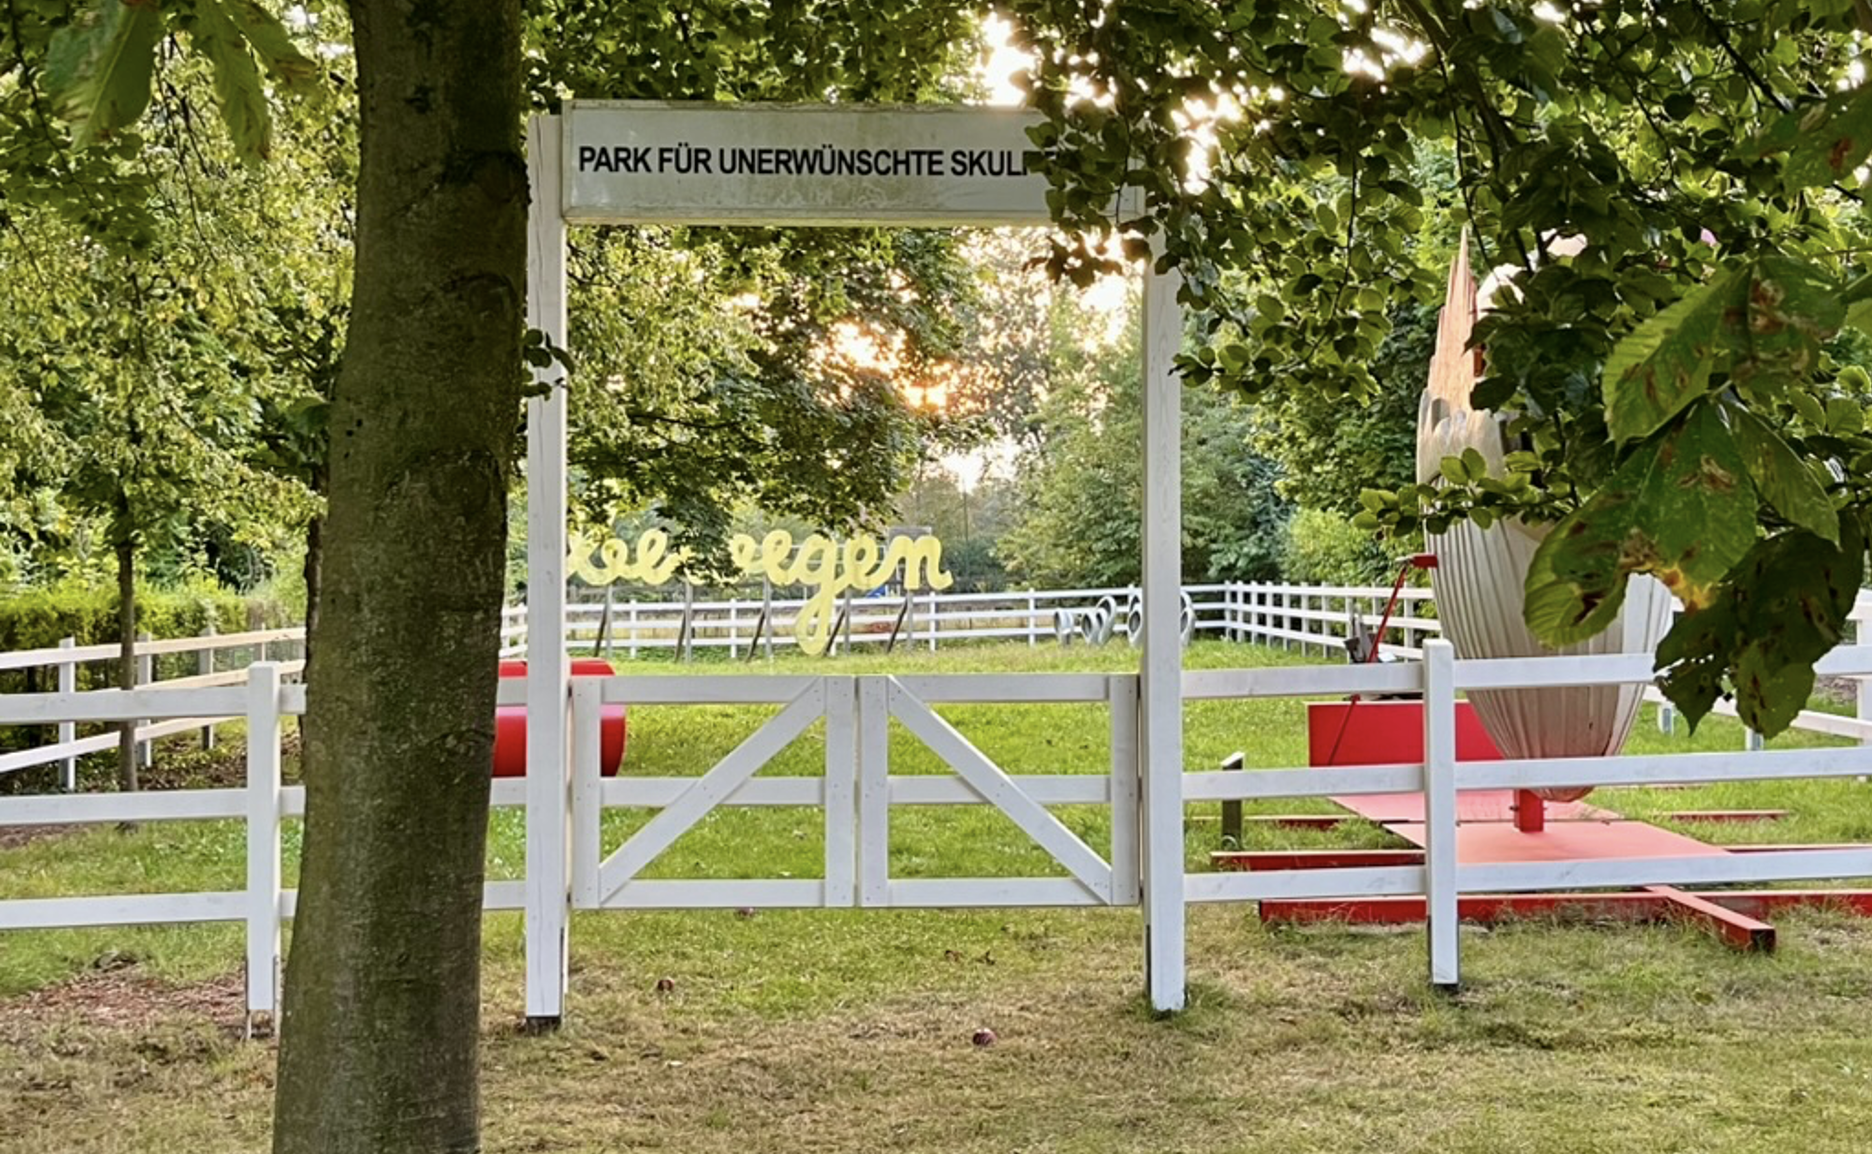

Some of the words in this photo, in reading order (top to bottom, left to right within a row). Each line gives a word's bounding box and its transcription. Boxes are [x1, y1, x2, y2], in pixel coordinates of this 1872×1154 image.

[578, 146, 652, 173] PARK
[658, 142, 712, 174] FÜR
[719, 143, 945, 176] UNERWÜNSCHTE
[950, 150, 1030, 177] SKUL
